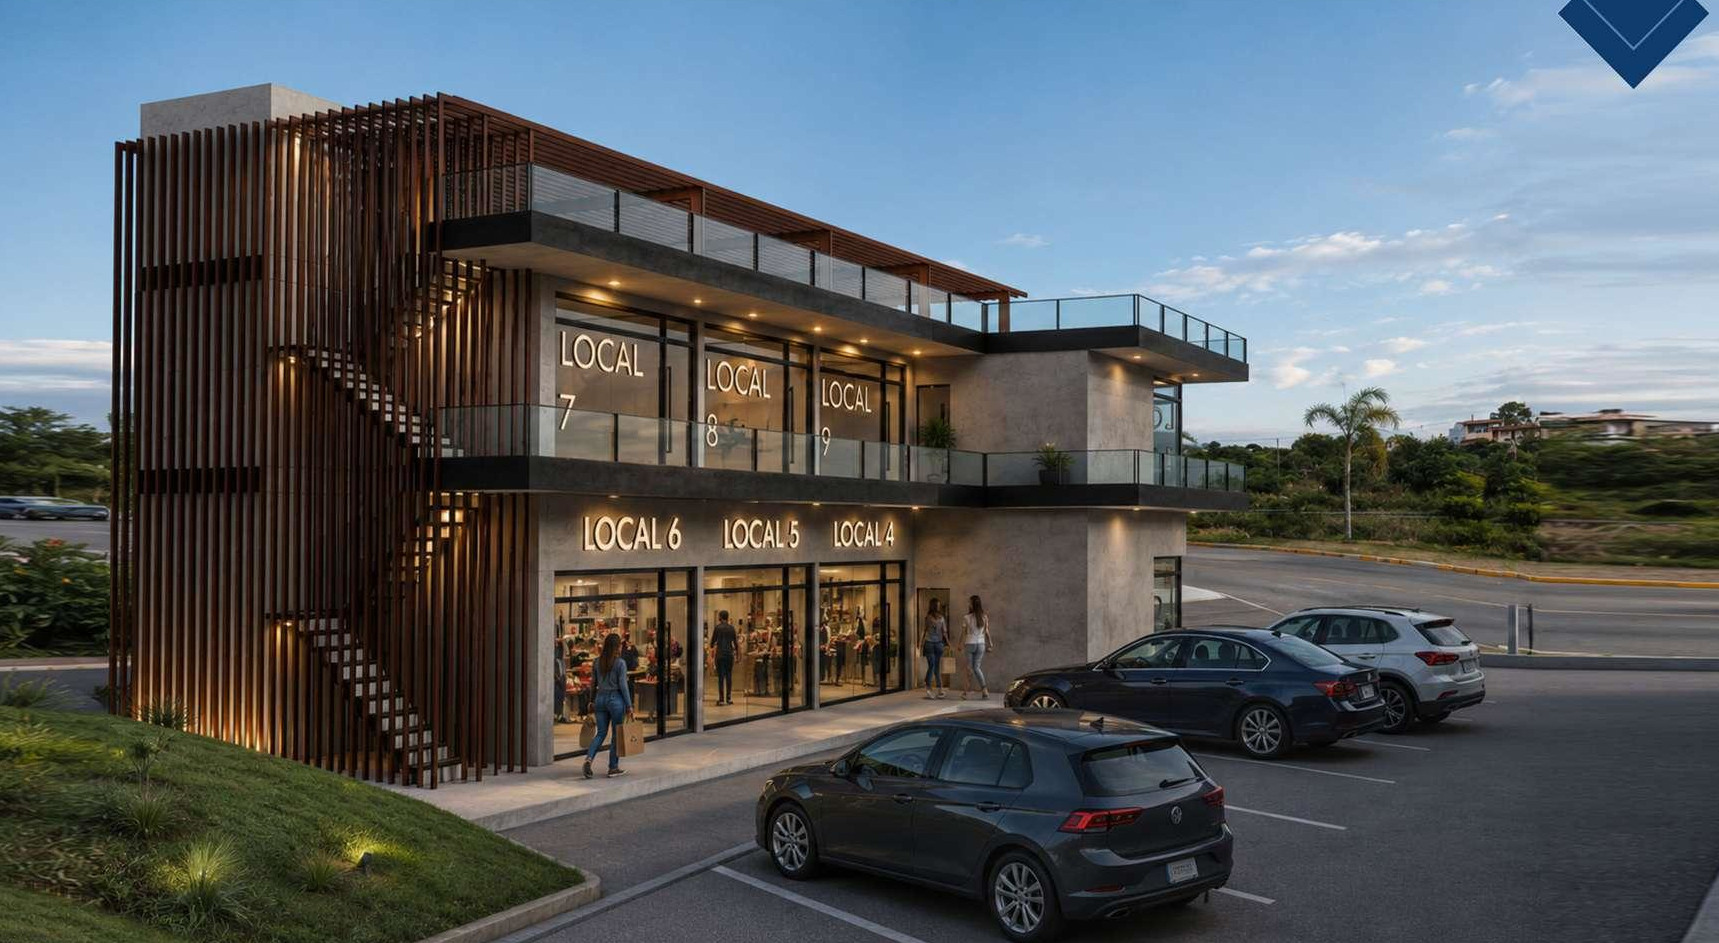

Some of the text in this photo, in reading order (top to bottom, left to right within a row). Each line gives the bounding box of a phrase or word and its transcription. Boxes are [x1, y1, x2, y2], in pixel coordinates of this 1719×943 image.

[560, 331, 644, 377] LOCAL
[706, 358, 771, 399] LOCAL
[821, 378, 872, 413] LOCAL
[558, 394, 576, 430] 7
[706, 413, 719, 447] 8
[820, 426, 831, 456] 9
[583, 516, 682, 551] LOCAL 6
[723, 519, 800, 548] LOCAL 5
[834, 521, 895, 547] LOCAL 4
